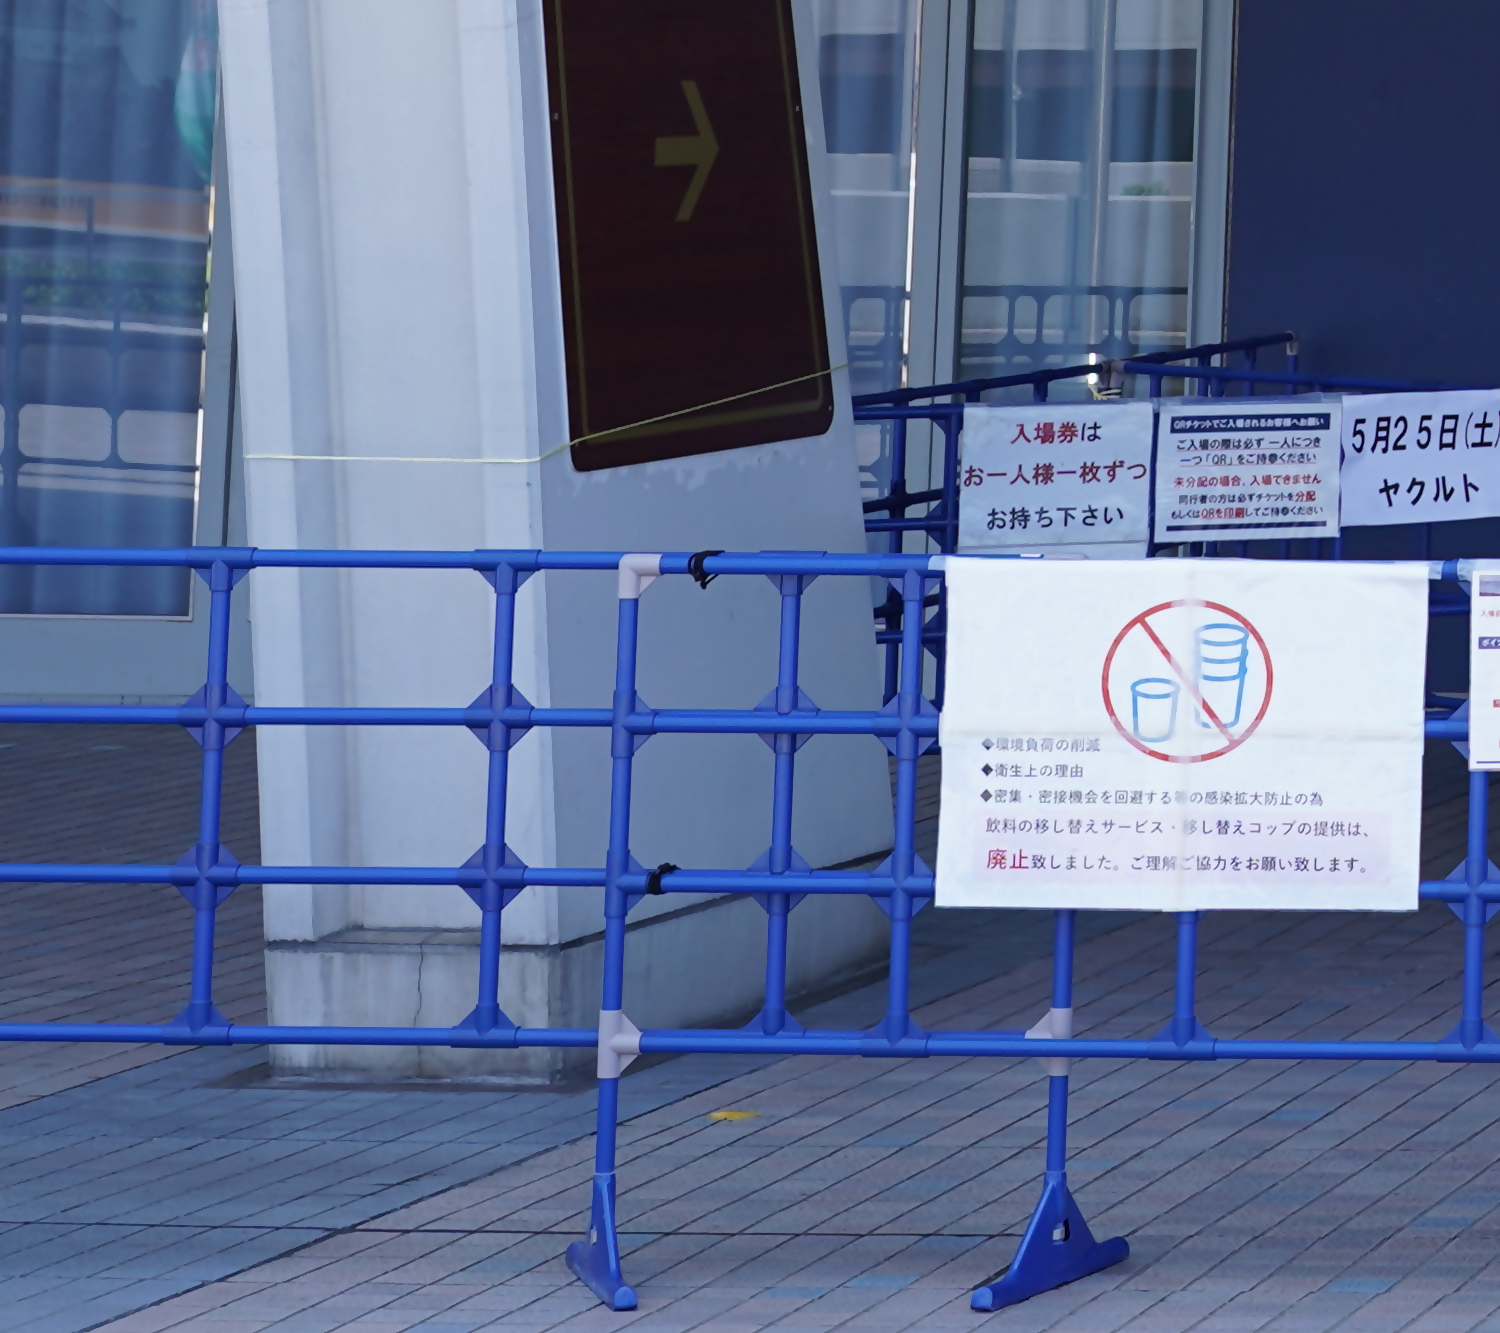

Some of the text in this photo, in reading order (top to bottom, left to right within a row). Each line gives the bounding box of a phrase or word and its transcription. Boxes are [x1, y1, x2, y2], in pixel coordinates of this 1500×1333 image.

[1010, 422, 1102, 445] 入場券は
[963, 459, 1148, 487] お一人様一枚ずつ
[1379, 473, 1479, 507] ヤクルト
[986, 505, 1124, 530] お持ち下さい
